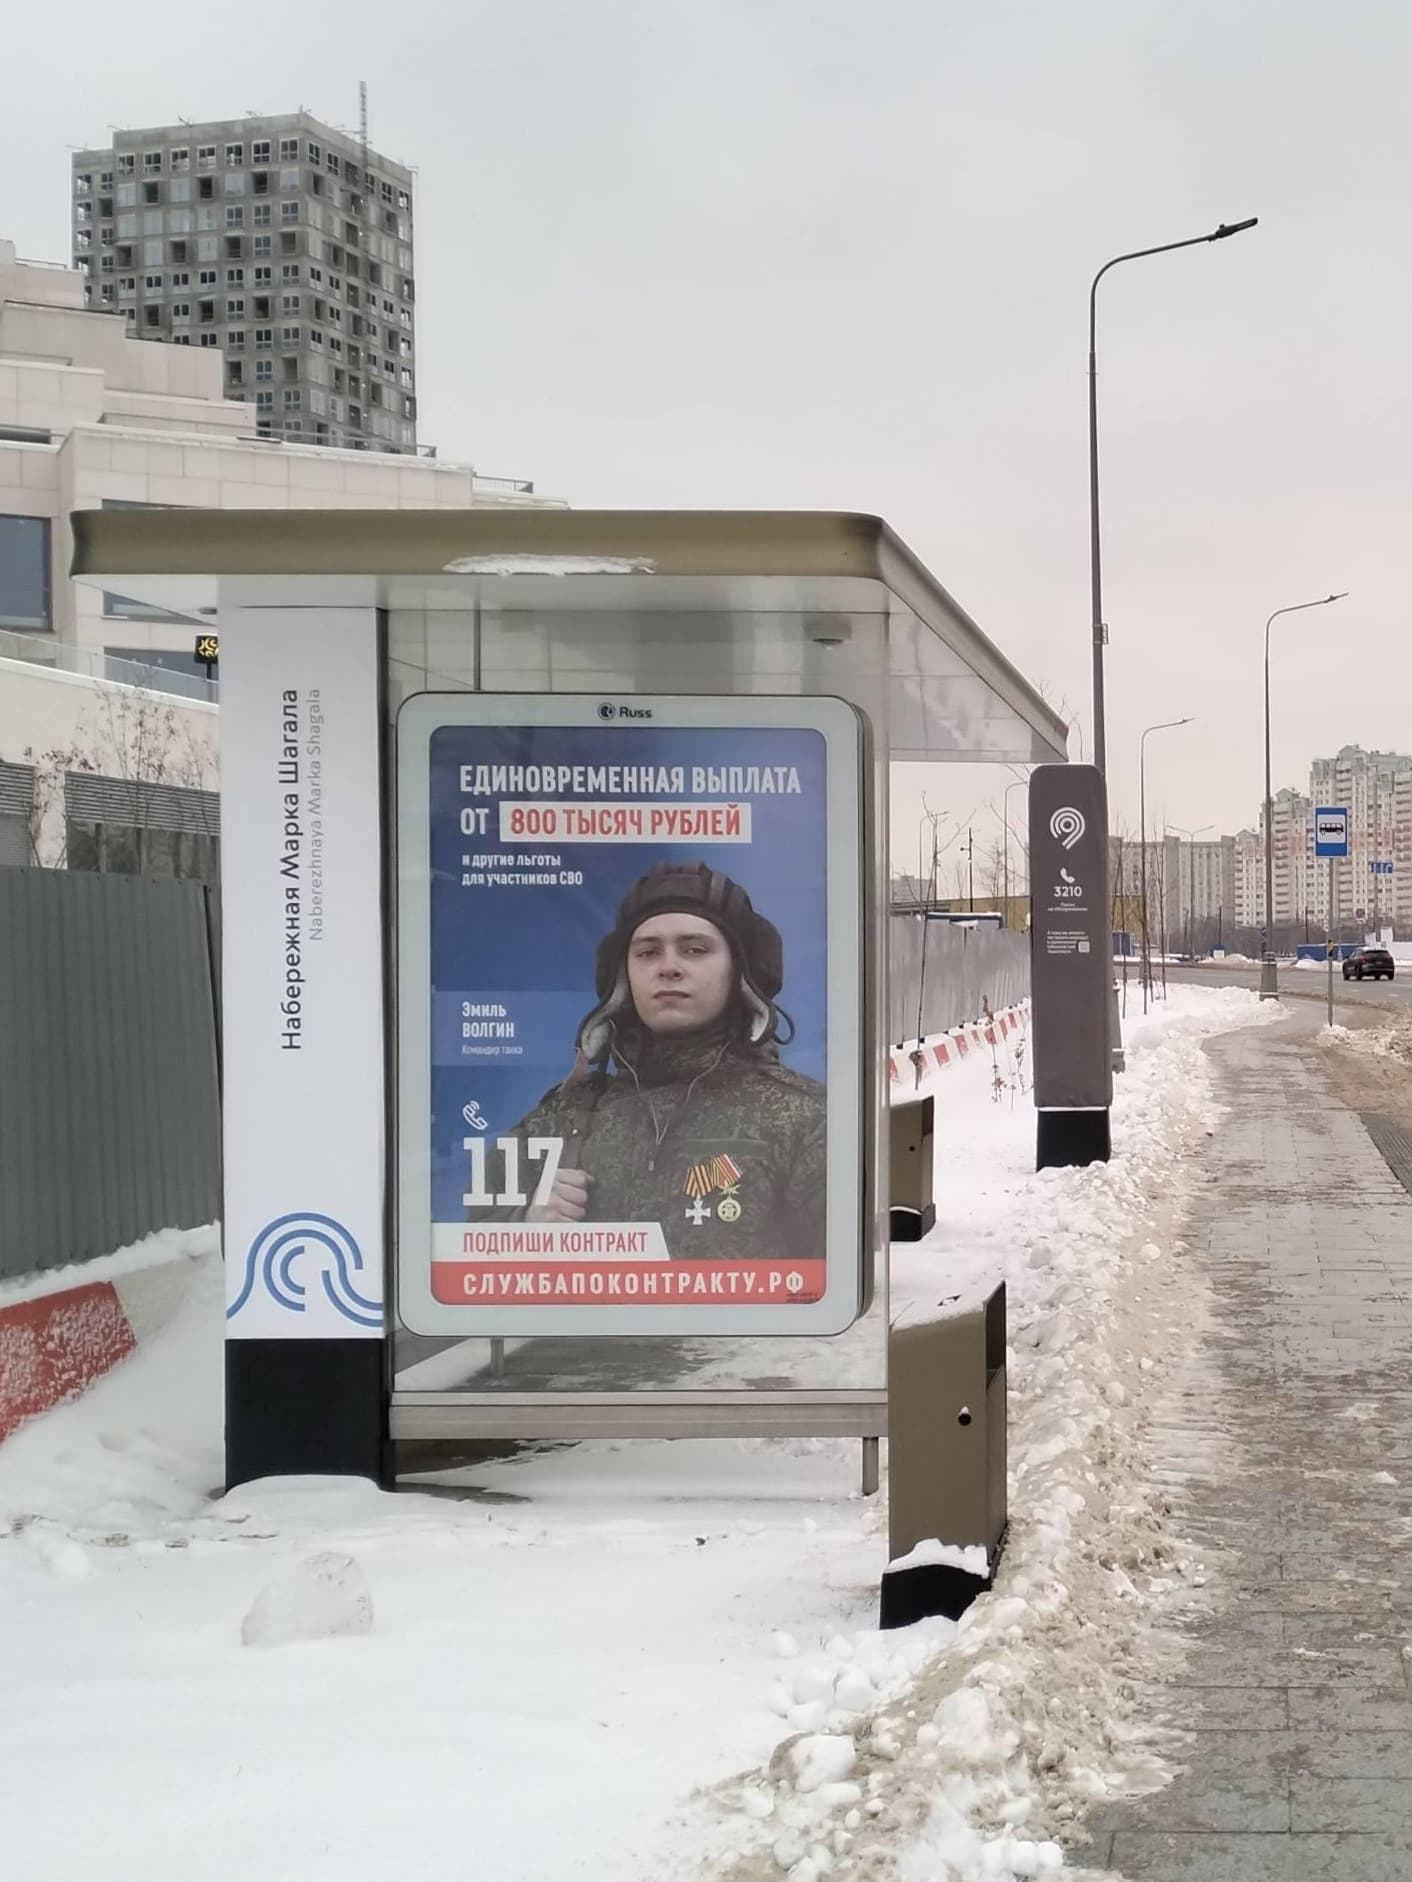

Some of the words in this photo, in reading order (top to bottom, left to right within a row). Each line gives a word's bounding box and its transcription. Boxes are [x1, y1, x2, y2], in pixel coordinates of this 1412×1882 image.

[308, 689, 326, 755] Shagala
[619, 706, 652, 718] Russ
[278, 689, 298, 784] Шагала
[308, 760, 321, 816] Marka
[459, 765, 685, 795] ЕДИНОВРЕМЕННАЯ
[691, 766, 802, 794] ВЫПЛАТА
[459, 808, 489, 835] ОТ
[510, 808, 557, 835] 800
[563, 808, 642, 836] ТЫСЯЧ
[650, 803, 741, 836] РУБЛЕЙ
[279, 793, 304, 880] Марка
[472, 853, 514, 868] другие
[516, 853, 561, 868] льготы
[308, 820, 326, 941] Naberezhnaya
[462, 872, 485, 886] для
[487, 872, 557, 886] участников
[559, 870, 583, 885] СВО
[1053, 886, 1082, 897] 3210
[280, 886, 306, 1050] Набережная
[462, 1001, 507, 1017] Эмиль
[462, 1022, 515, 1038] ВОЛГИН
[463, 1137, 563, 1206] 117
[463, 1232, 553, 1255] ПОДПИШИ
[559, 1232, 648, 1253] КОНТРАКТ
[463, 1271, 804, 1296] СЛУЖБАПОКОНТРАКТУ.РФ
